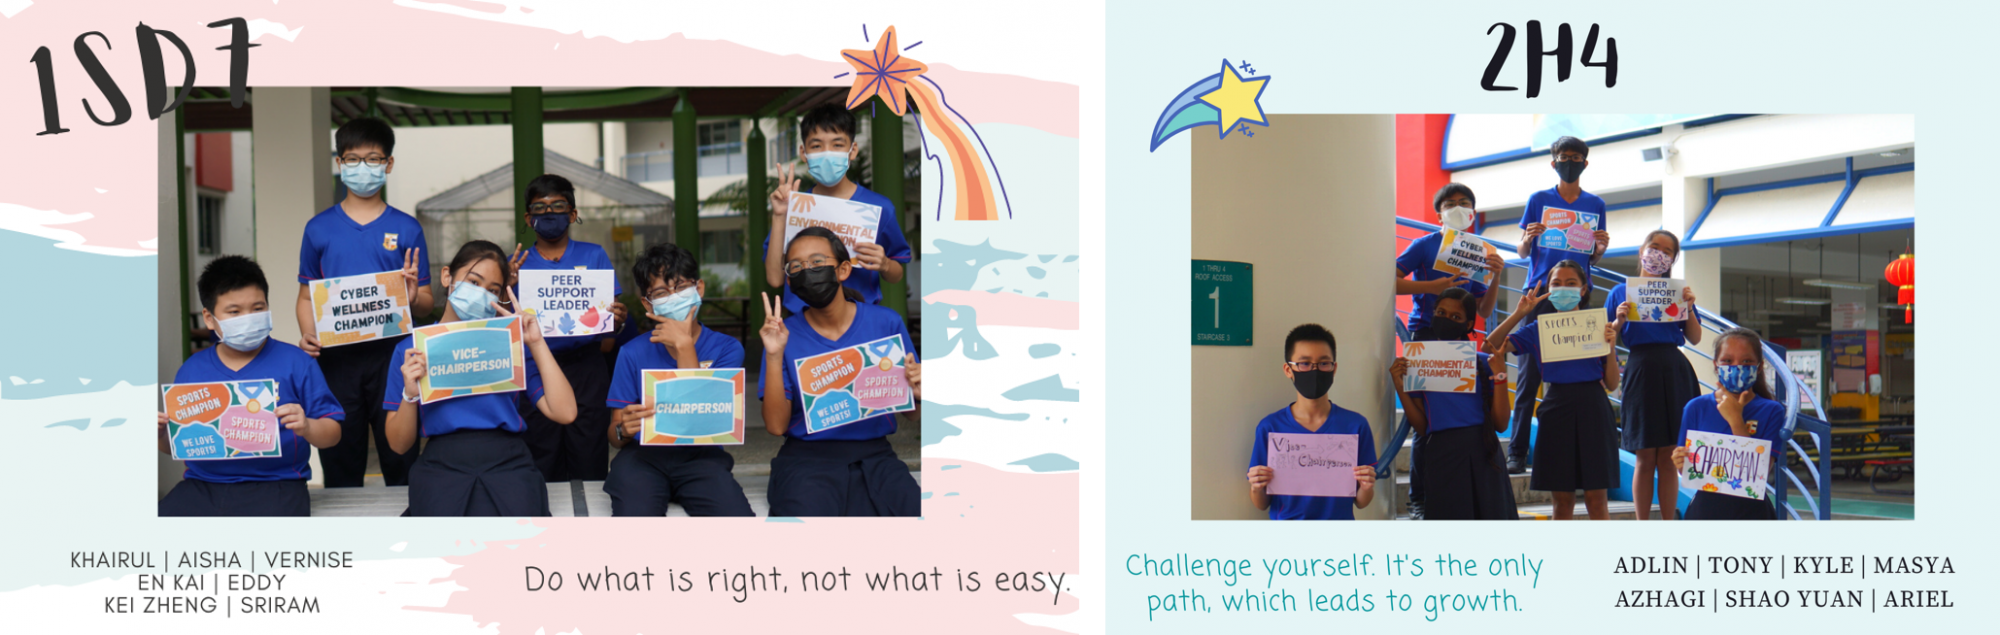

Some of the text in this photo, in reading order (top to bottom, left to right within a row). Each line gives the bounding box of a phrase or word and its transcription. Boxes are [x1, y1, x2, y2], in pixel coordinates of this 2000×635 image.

[788, 215, 875, 240] ENVIRONMENTAL
[1546, 218, 1571, 226] CHAMPION
[1573, 229, 1590, 239] SPORTS
[1460, 240, 1484, 253] CYBER
[1451, 248, 1487, 263] WELLNESS
[1447, 257, 1484, 273] CHAMPION
[551, 275, 582, 285] PEER
[1195, 273, 1233, 282] ROOF ACCESS
[1647, 281, 1668, 289] PEER
[340, 285, 378, 300] CYBER
[537, 287, 596, 298] SUPPORT
[1638, 289, 1676, 297] SUPPORT
[543, 300, 590, 311] LEADER
[1208, 286, 1220, 329] 1
[1641, 297, 1673, 305] LEADER
[332, 299, 391, 317] WELLNESS
[334, 313, 393, 331] CHAMPION
[1197, 333, 1225, 341] STAIRCASE
[1552, 333, 1593, 348] Champion
[452, 347, 486, 360] VICE-
[430, 357, 510, 376] CHAIRPERSON
[810, 354, 844, 378] SPORTS
[1406, 359, 1475, 369] ENVIRONMENTAL
[810, 362, 855, 392] CHAMPION
[1418, 369, 1462, 378] CHAMPION
[865, 375, 898, 387] SPORTS
[177, 387, 211, 406] SPORTS
[858, 387, 904, 400] CHAMPION
[175, 398, 222, 420] CHAMPION
[656, 402, 733, 414] CHAIRPERSON
[816, 399, 850, 418] WE LOVE
[231, 416, 266, 430] SPORTS
[821, 409, 851, 428] SPORTS!
[182, 435, 215, 447] WE LOVE
[223, 428, 272, 444] CHAMPION
[186, 445, 216, 457] SPORTS!
[1694, 445, 1760, 483] CHAIRMAN
